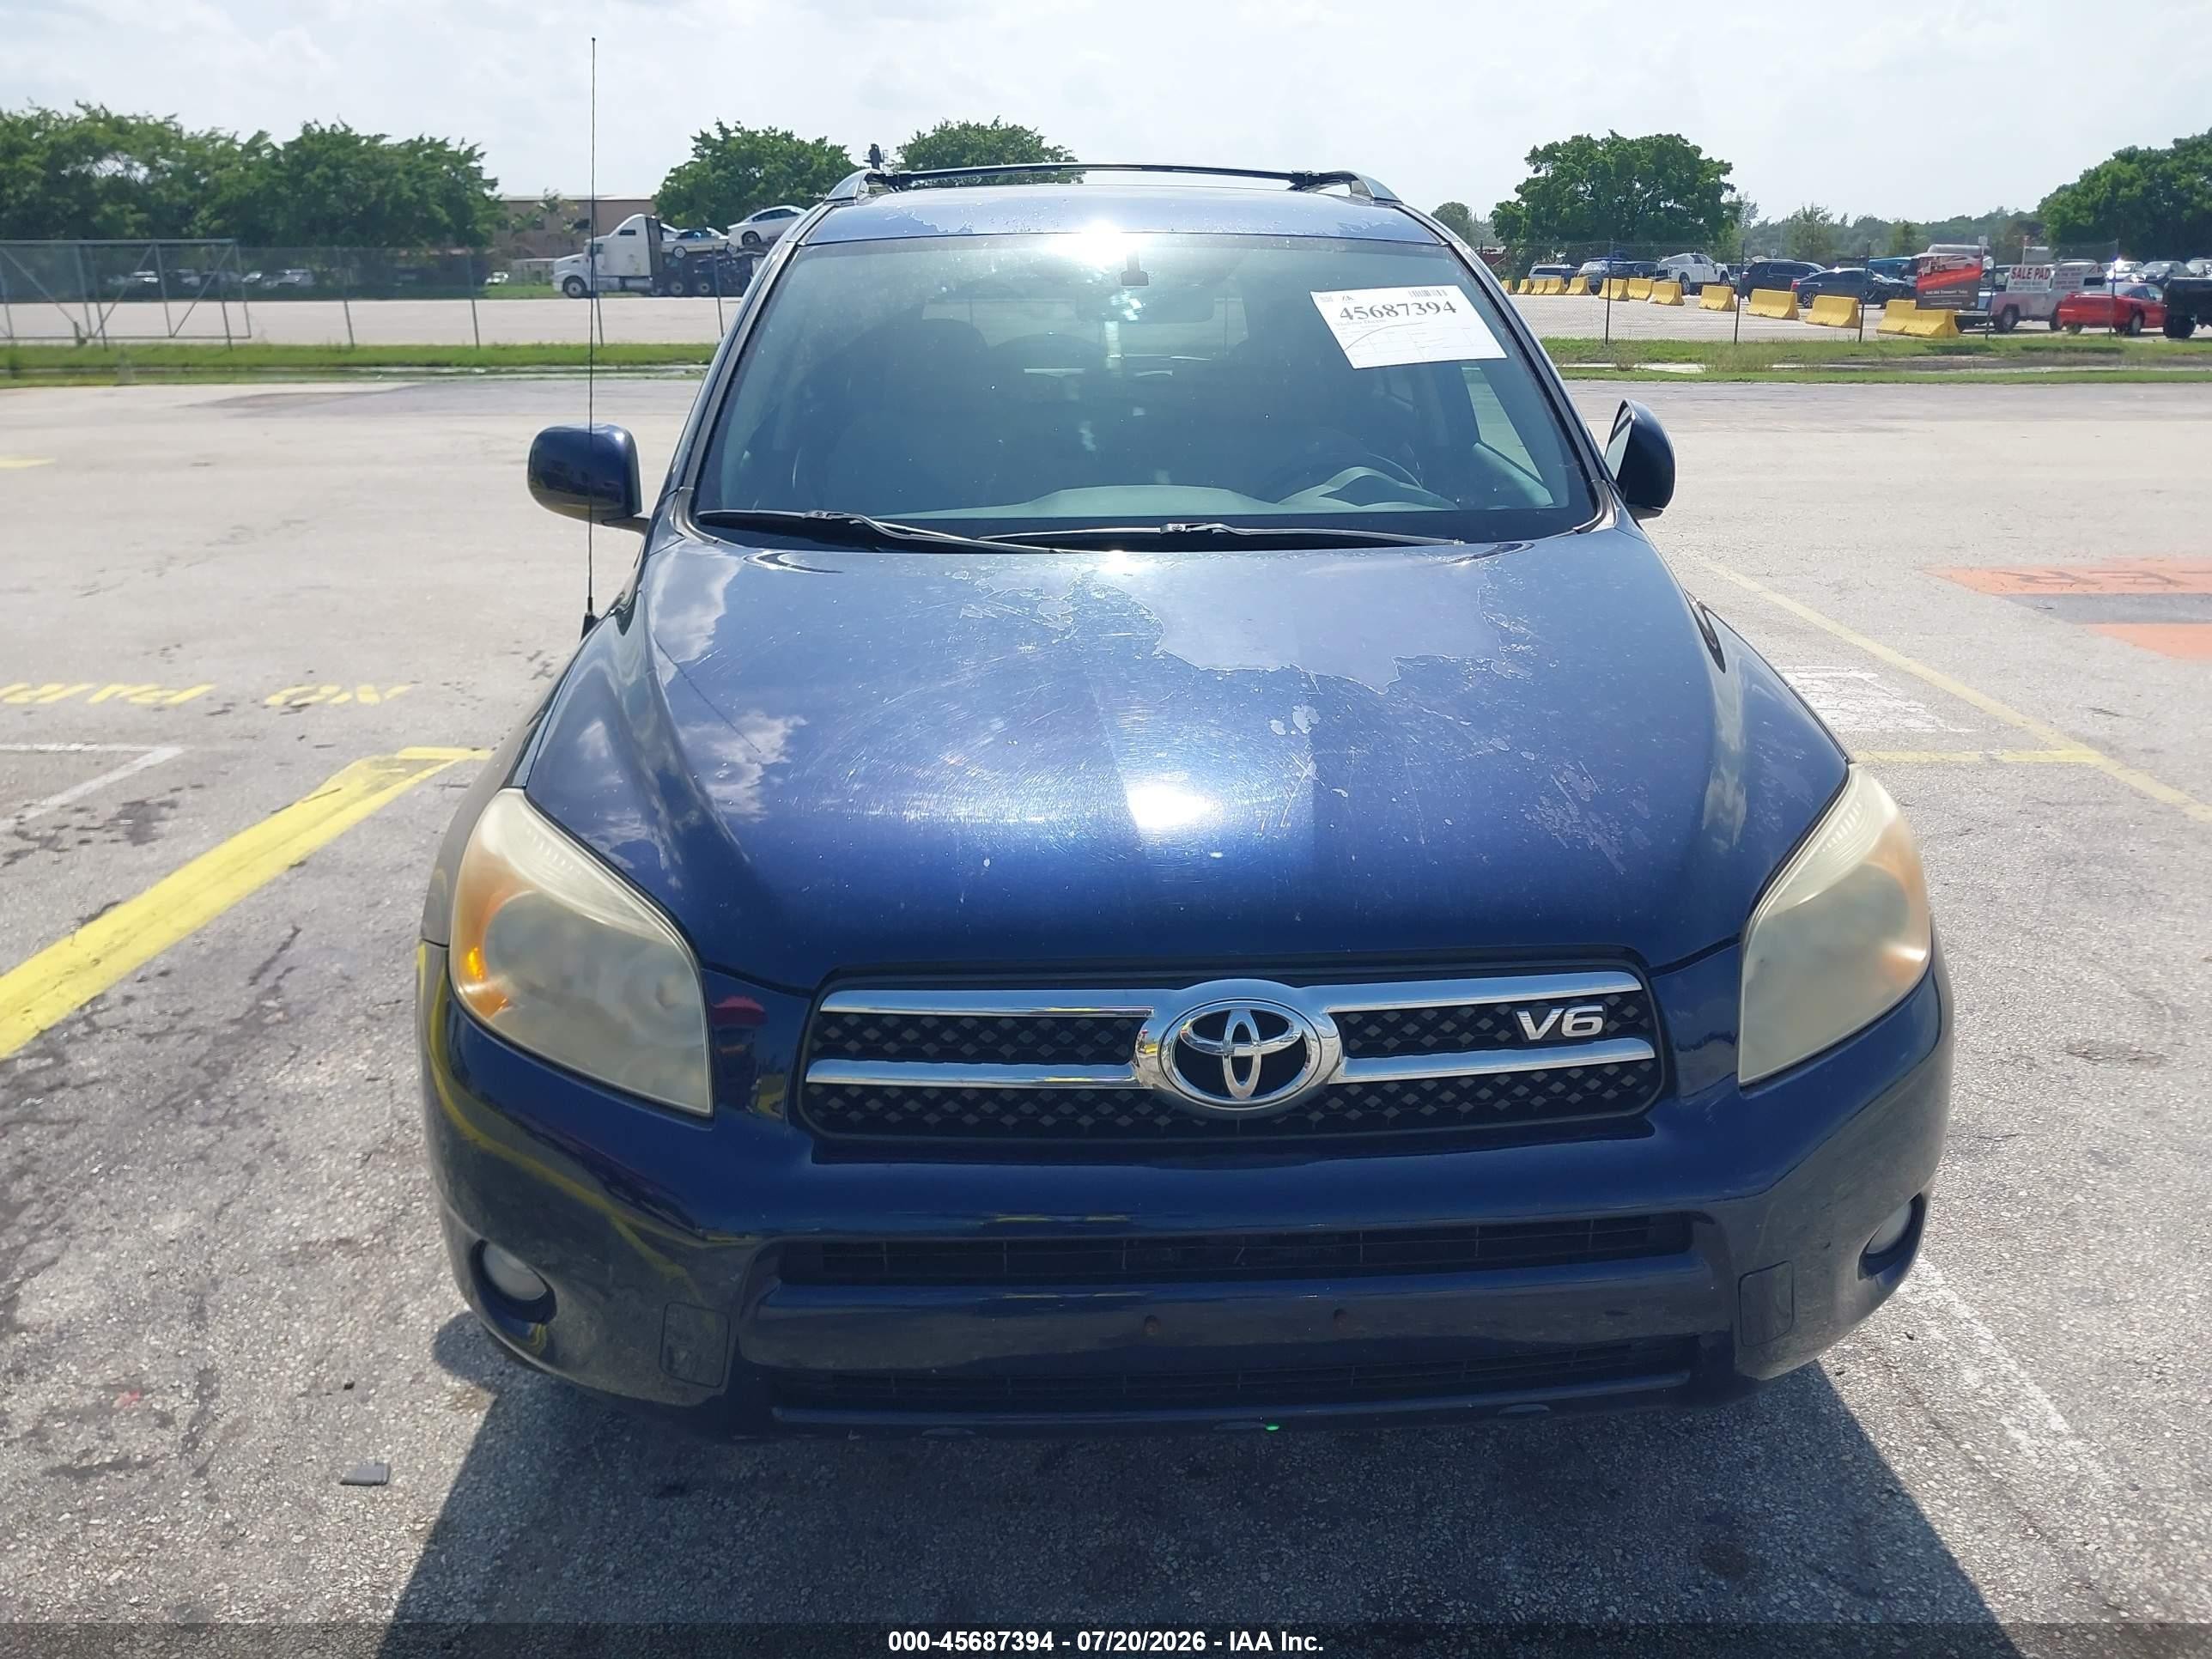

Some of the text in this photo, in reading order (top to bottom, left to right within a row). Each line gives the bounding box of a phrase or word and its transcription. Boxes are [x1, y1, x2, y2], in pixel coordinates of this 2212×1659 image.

[2010, 267, 2051, 281] SALE PAD
[1340, 301, 1457, 320] 45687394
[1516, 1005, 1604, 1040] V6
